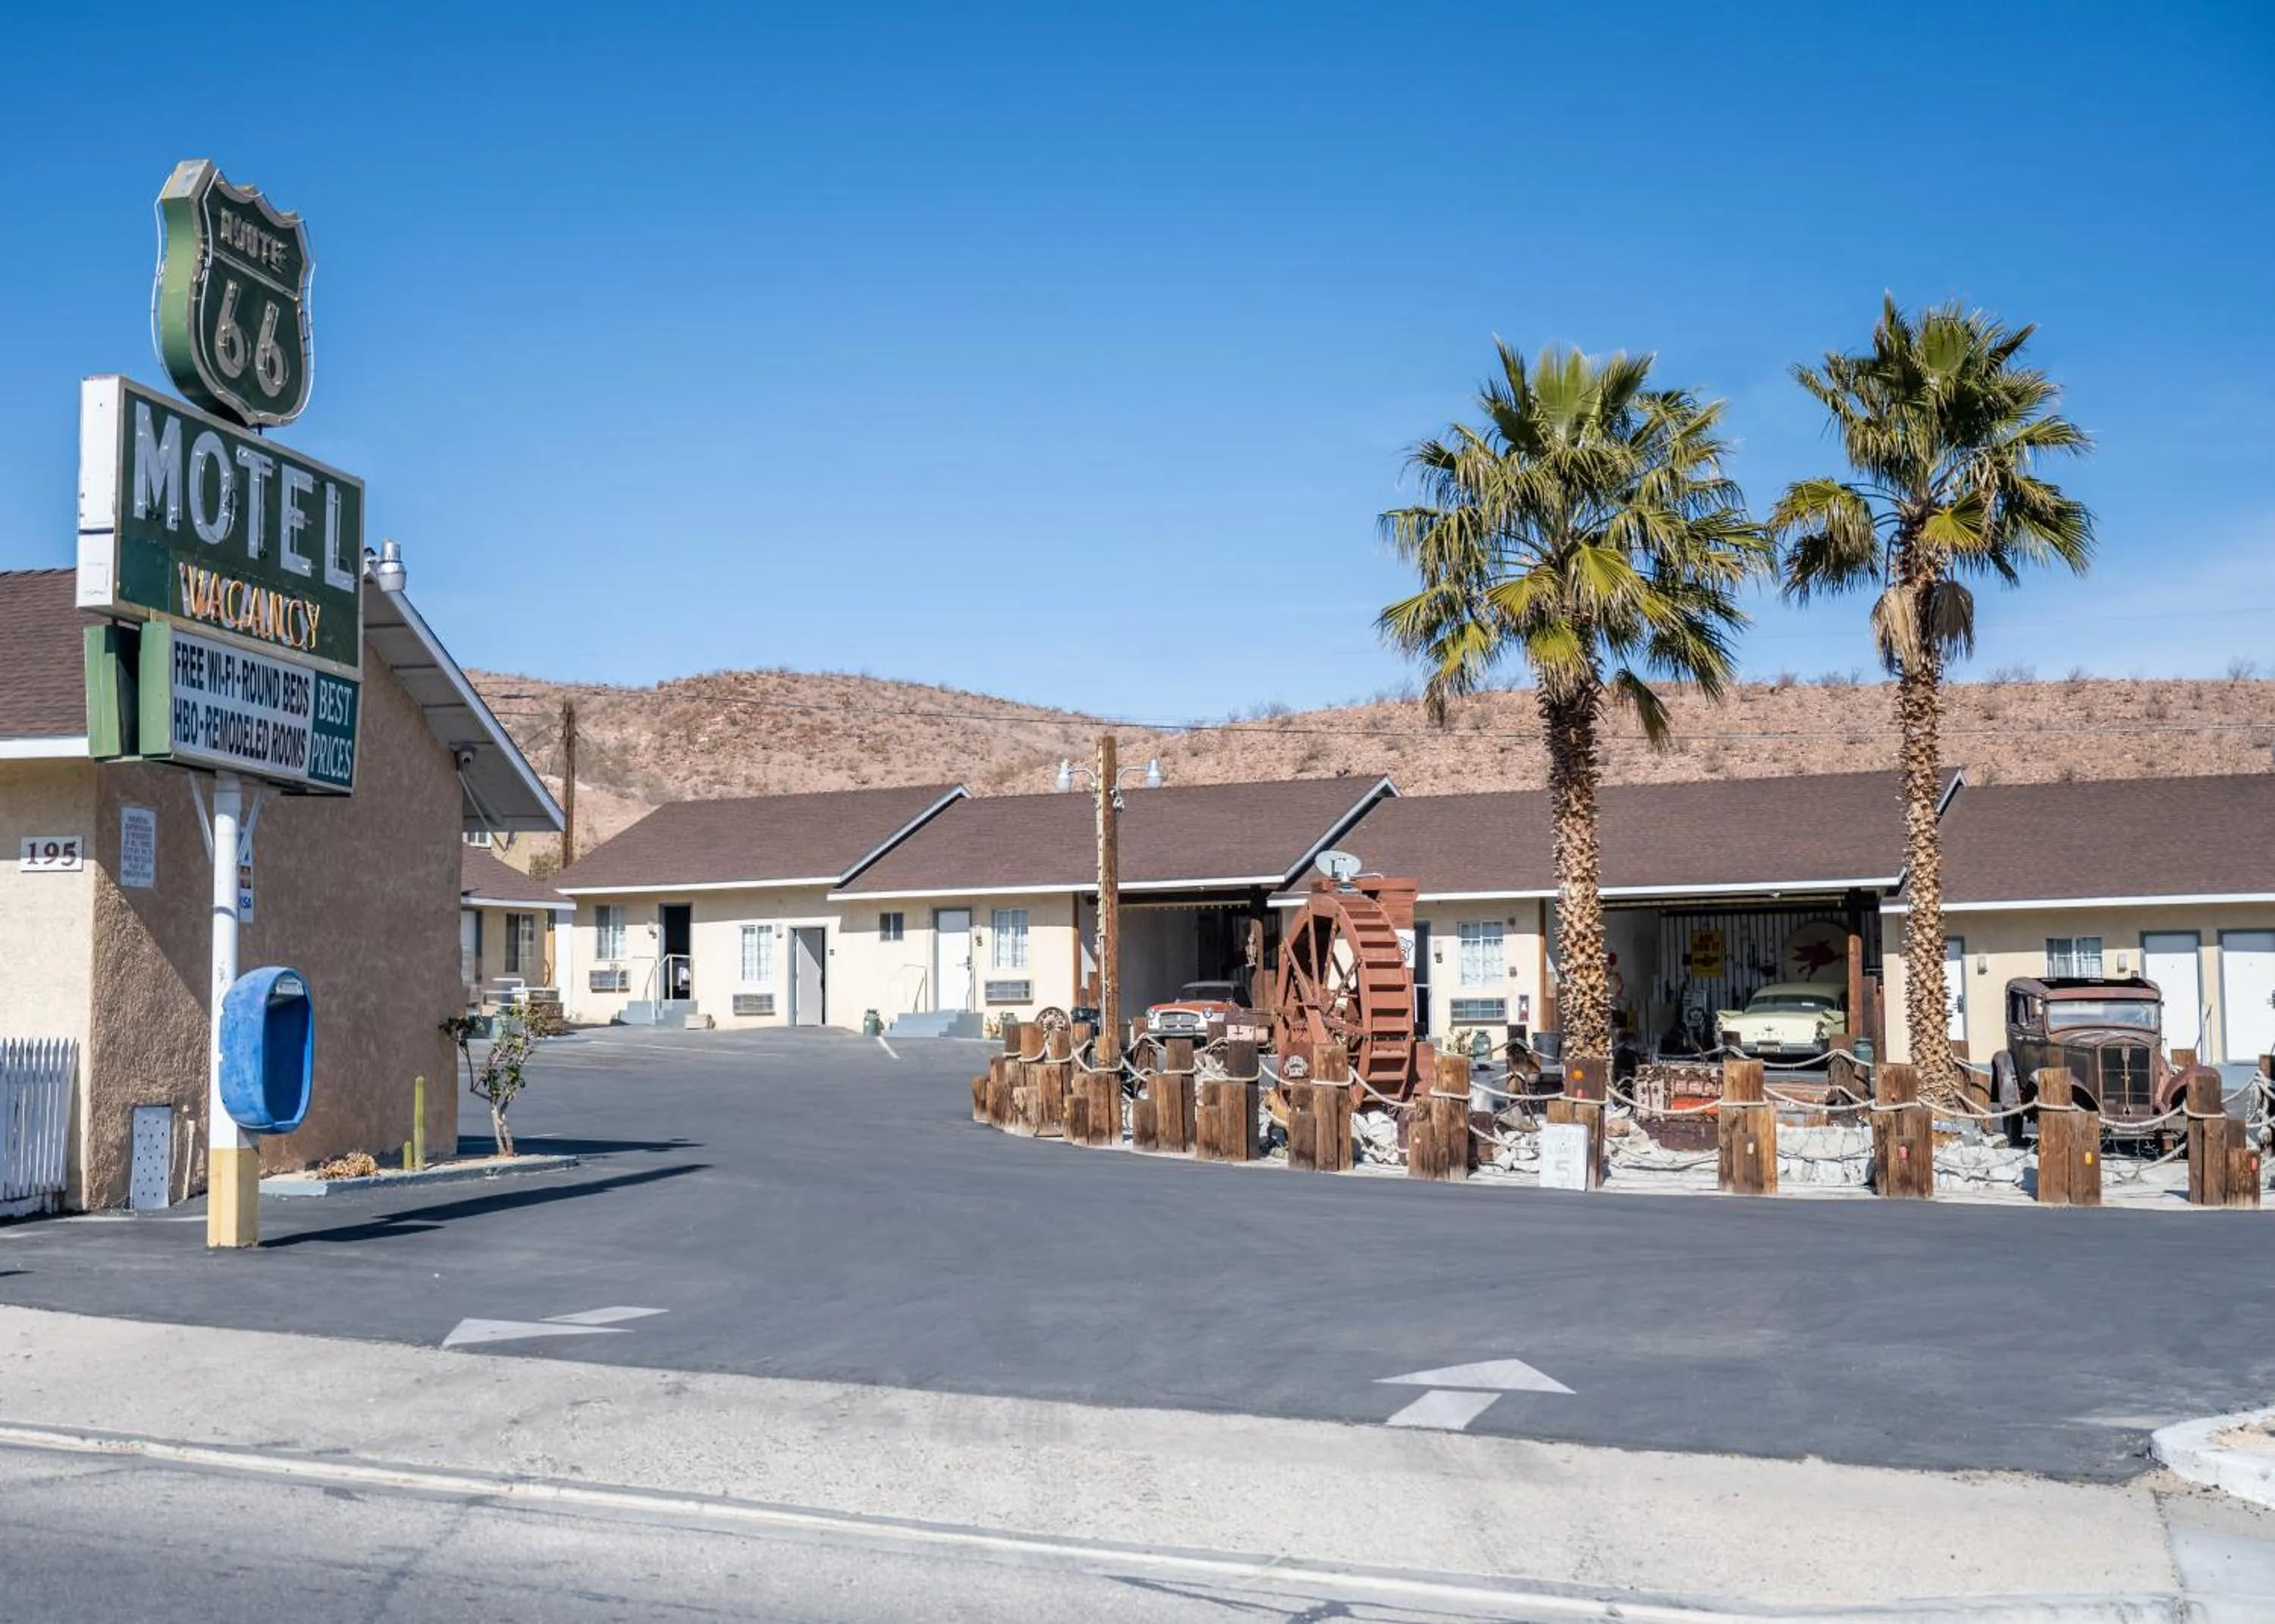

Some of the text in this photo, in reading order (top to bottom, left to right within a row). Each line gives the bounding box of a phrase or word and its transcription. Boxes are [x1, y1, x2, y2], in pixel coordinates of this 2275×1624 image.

[221, 208, 287, 271] ROUTE
[215, 279, 288, 397] 66
[133, 400, 356, 593] MOTEL
[178, 562, 320, 651] VACANCY
[174, 641, 310, 719] FREE WI-FI ROUND BEDS
[318, 679, 353, 726] BEST
[174, 697, 307, 770] HBO REMODELED ROOMS
[309, 731, 353, 780] PRICES
[27, 841, 77, 867] 195
[1555, 1160, 1571, 1182] 5
